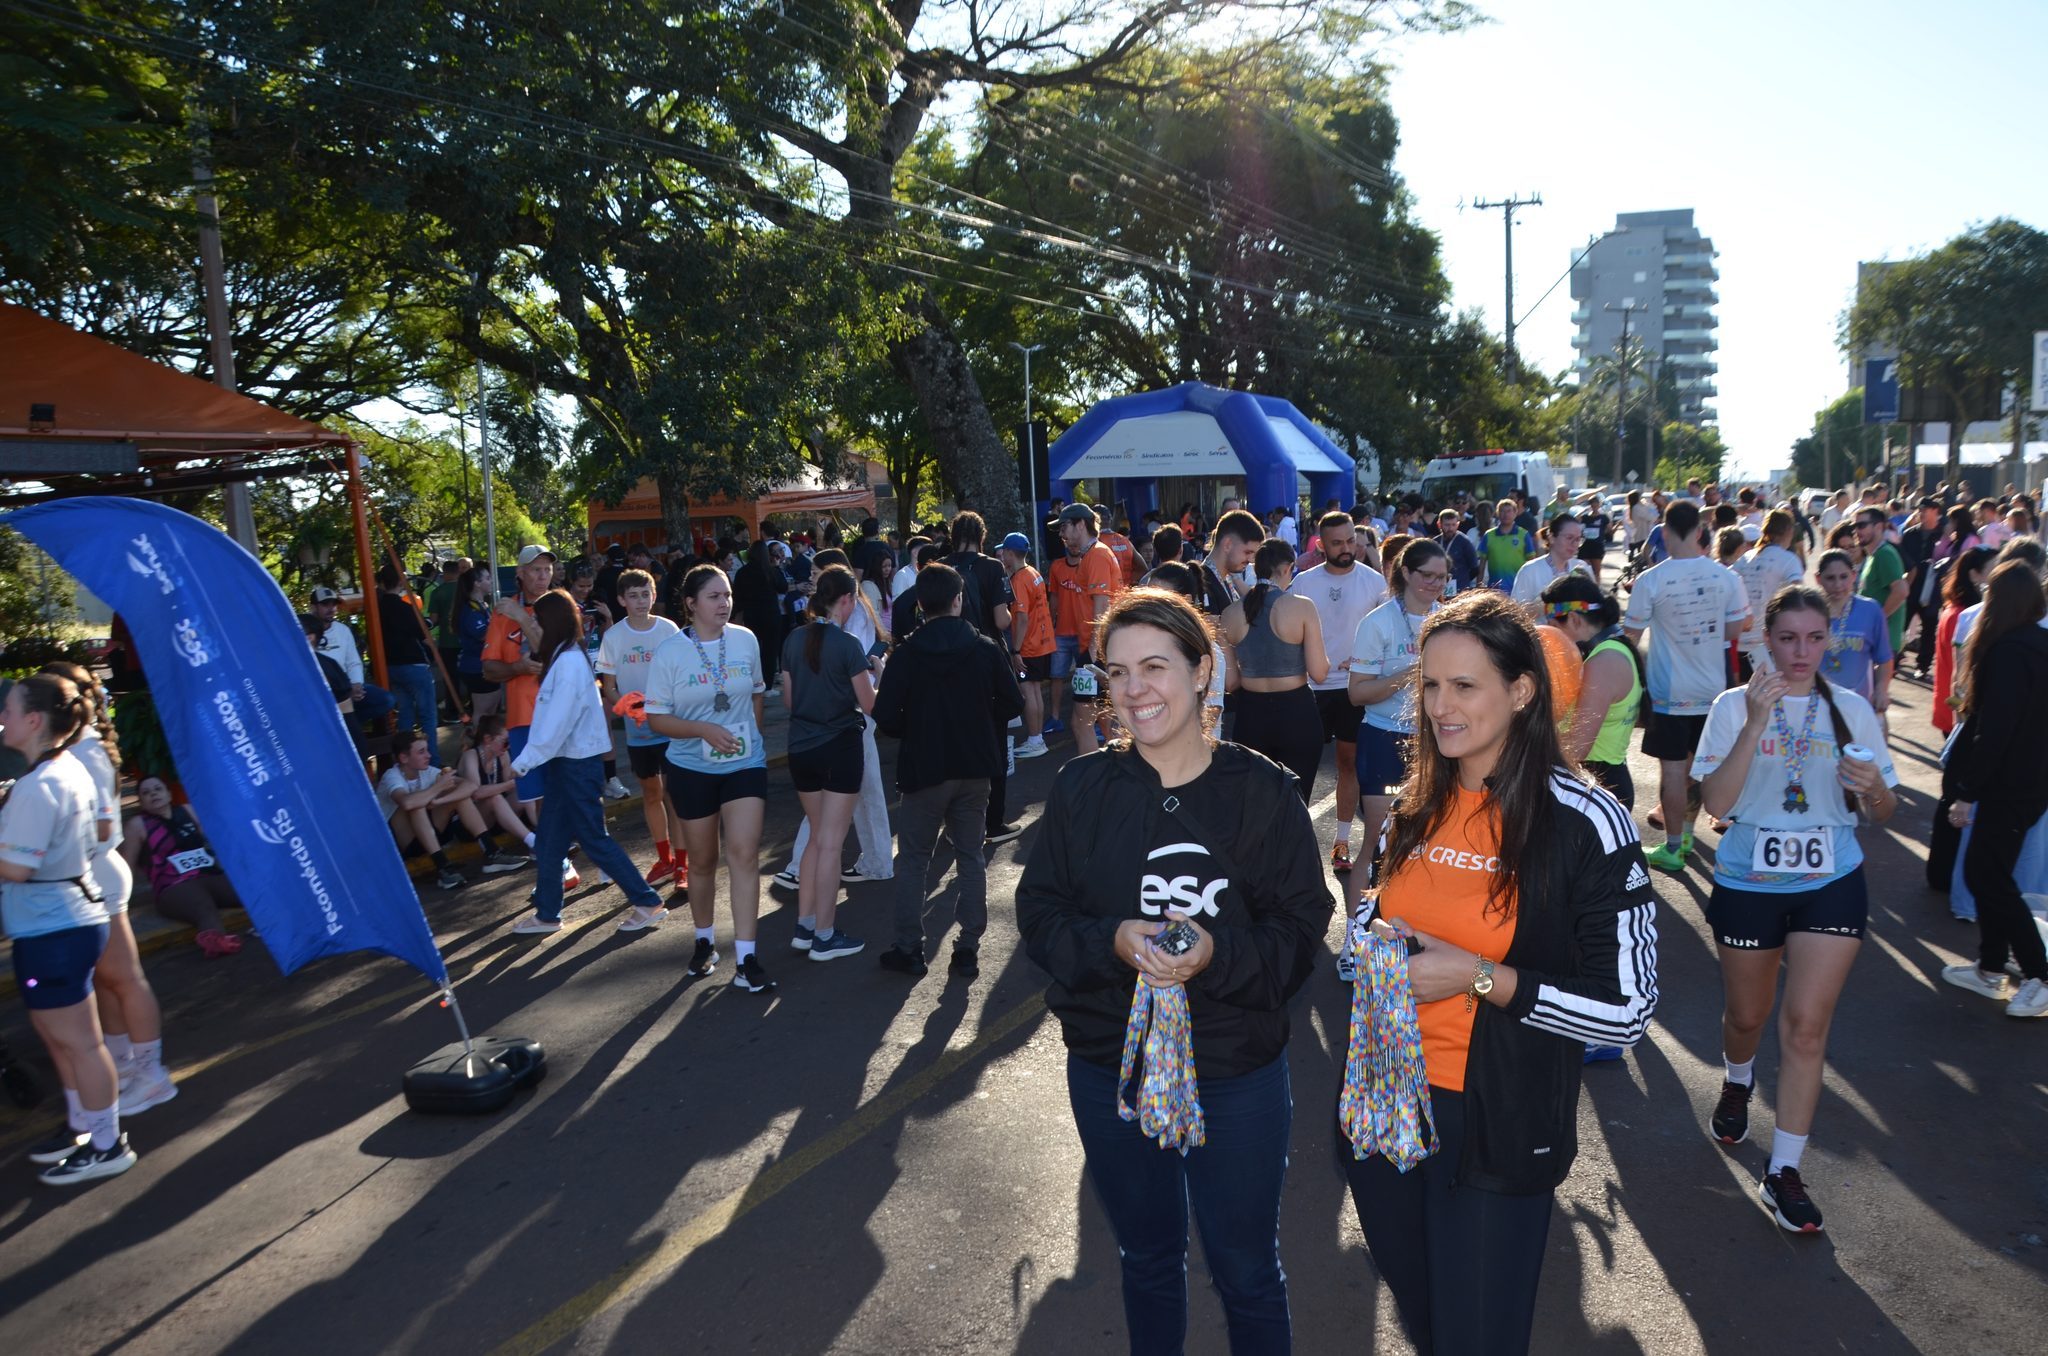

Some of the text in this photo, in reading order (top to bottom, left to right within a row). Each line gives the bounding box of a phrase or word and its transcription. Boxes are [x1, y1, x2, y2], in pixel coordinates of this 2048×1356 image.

[131, 533, 175, 595] Senac
[175, 618, 208, 668] Sesc
[622, 652, 653, 664] Autis
[213, 690, 269, 787] Sindicatos
[243, 678, 294, 776] Sistema Comércio
[1385, 785, 1401, 795] RU
[272, 808, 296, 837] RS
[1764, 837, 1823, 868] 696
[289, 836, 343, 936] Fecomércio
[1141, 874, 1229, 917] esc
[1625, 876, 1650, 892] adidas
[1724, 935, 1759, 947] RUN
